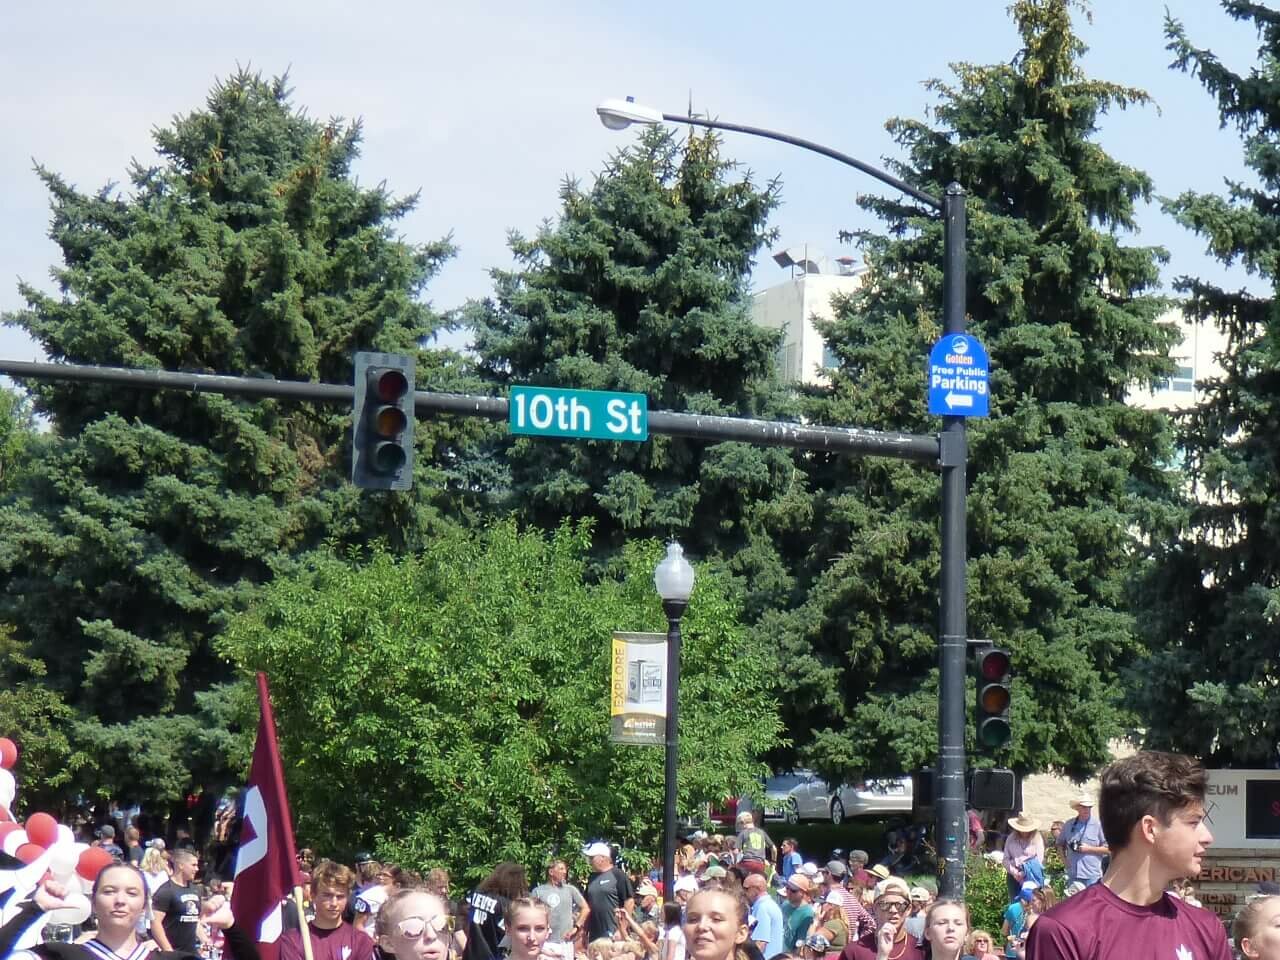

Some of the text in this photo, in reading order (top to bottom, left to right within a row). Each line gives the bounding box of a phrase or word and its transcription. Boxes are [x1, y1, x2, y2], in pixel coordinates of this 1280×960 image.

[946, 353, 973, 365] Golden
[932, 365, 987, 377] Free Public
[931, 374, 987, 395] Parking
[515, 393, 642, 435] 10th St
[614, 647, 624, 707] EXPLORE
[1192, 867, 1274, 882] ERICAN
